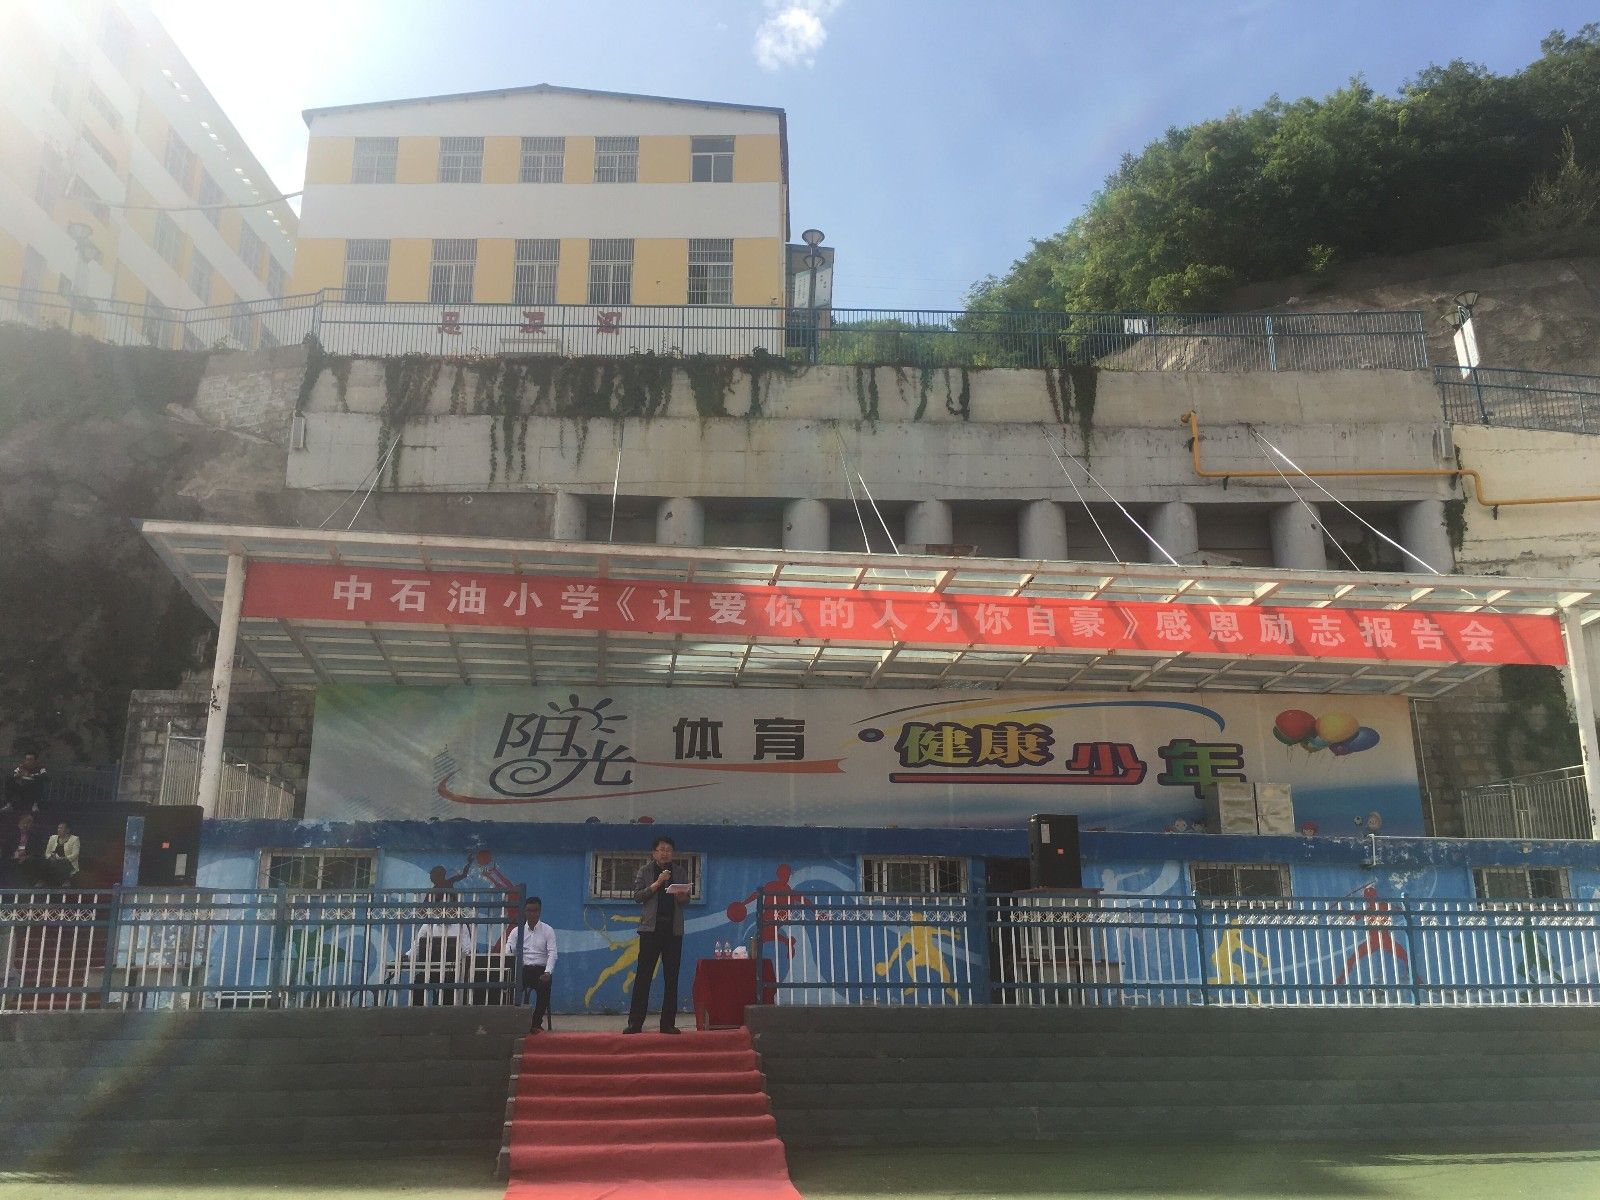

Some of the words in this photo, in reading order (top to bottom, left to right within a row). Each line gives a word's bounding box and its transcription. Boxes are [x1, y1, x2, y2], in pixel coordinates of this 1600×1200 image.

[333, 575, 1495, 653] 中石油小学《让爱你的人为你自豪》感恩励志报告会
